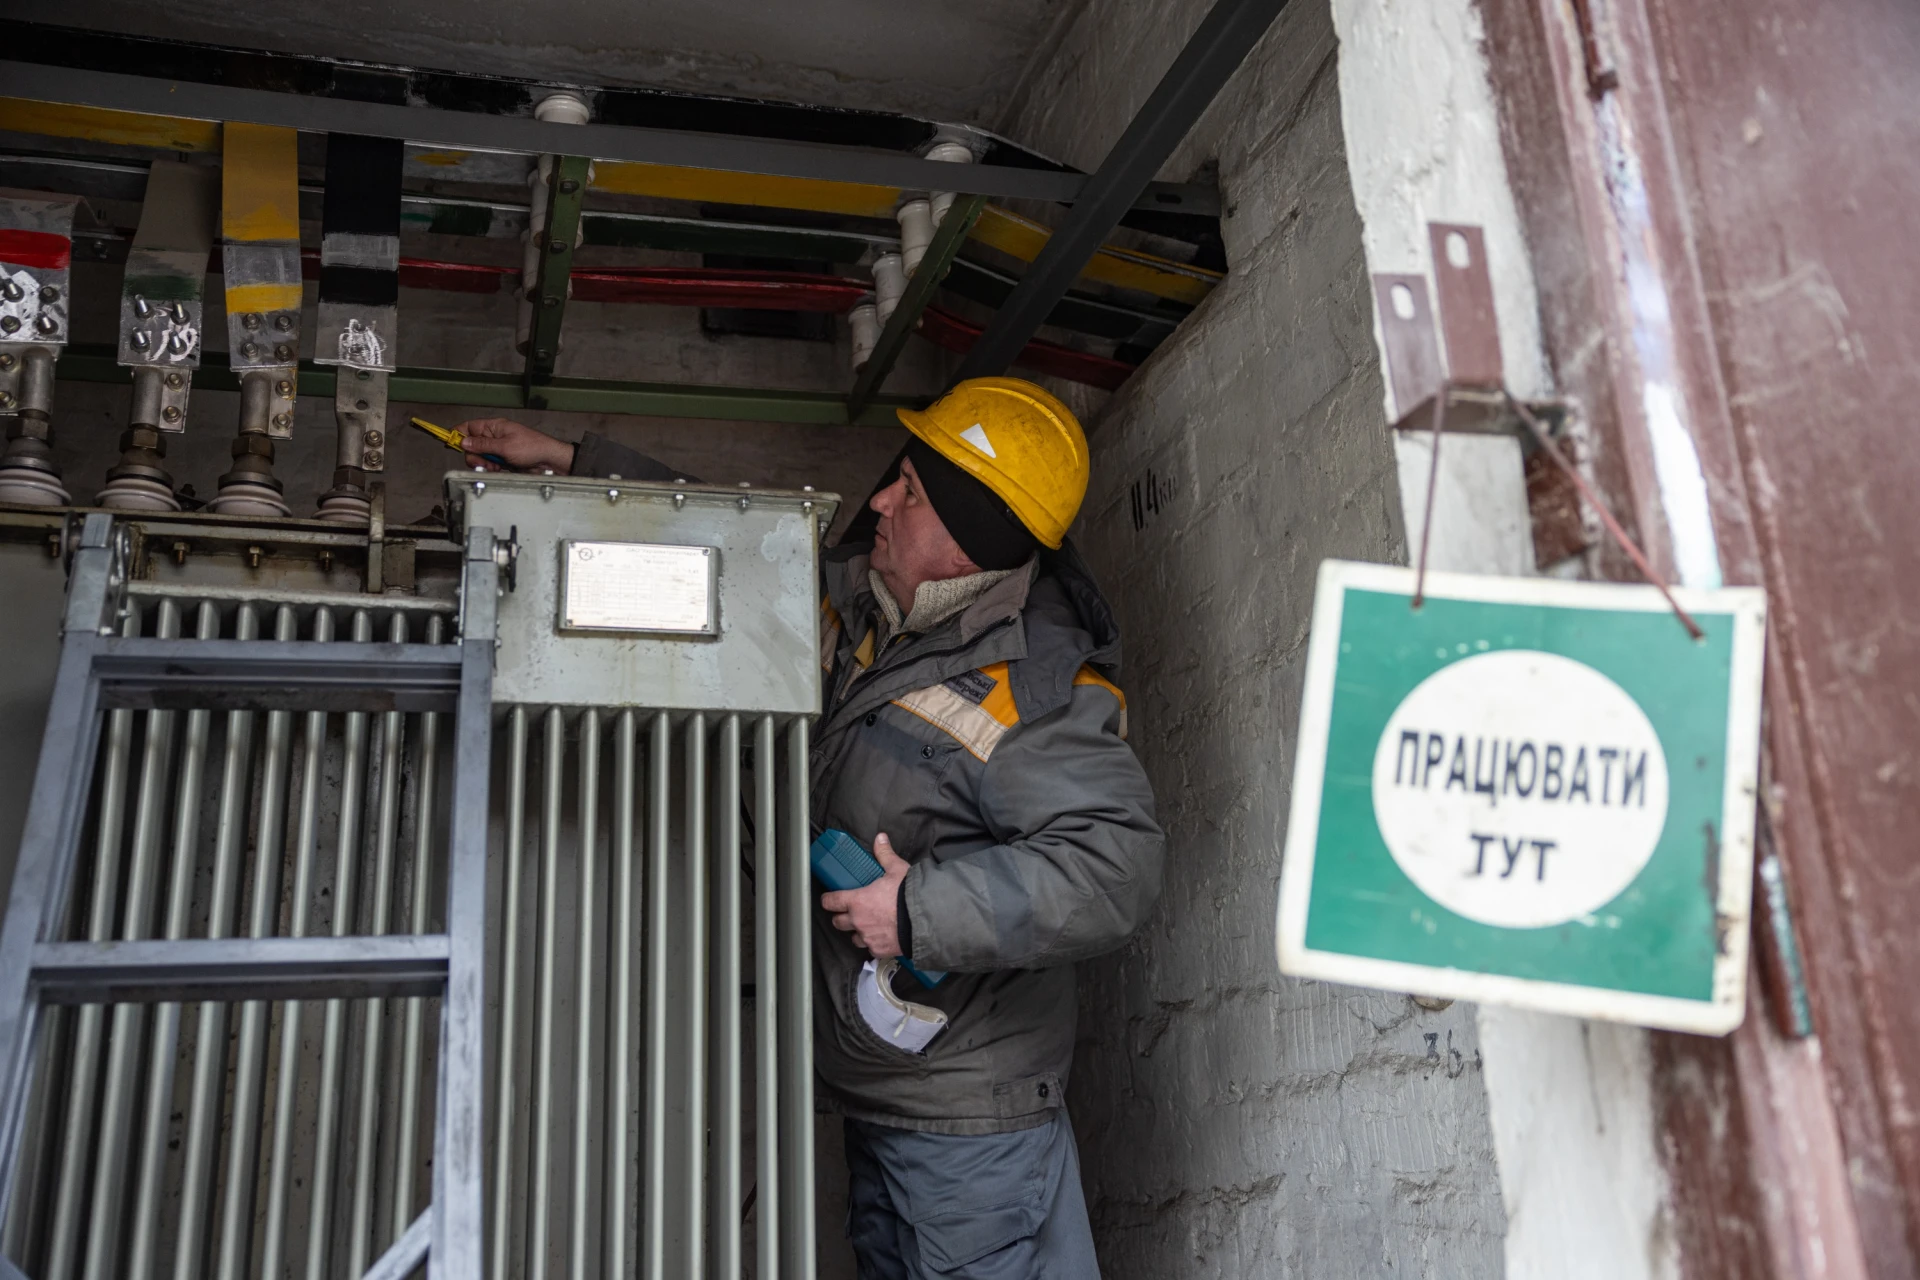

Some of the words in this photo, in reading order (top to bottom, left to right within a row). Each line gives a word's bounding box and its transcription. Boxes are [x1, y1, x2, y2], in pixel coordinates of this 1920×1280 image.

[965, 672, 993, 691] вські
[1394, 731, 1647, 808] ПРАЦЮВАТИ
[1471, 833, 1557, 882] ТУТ
